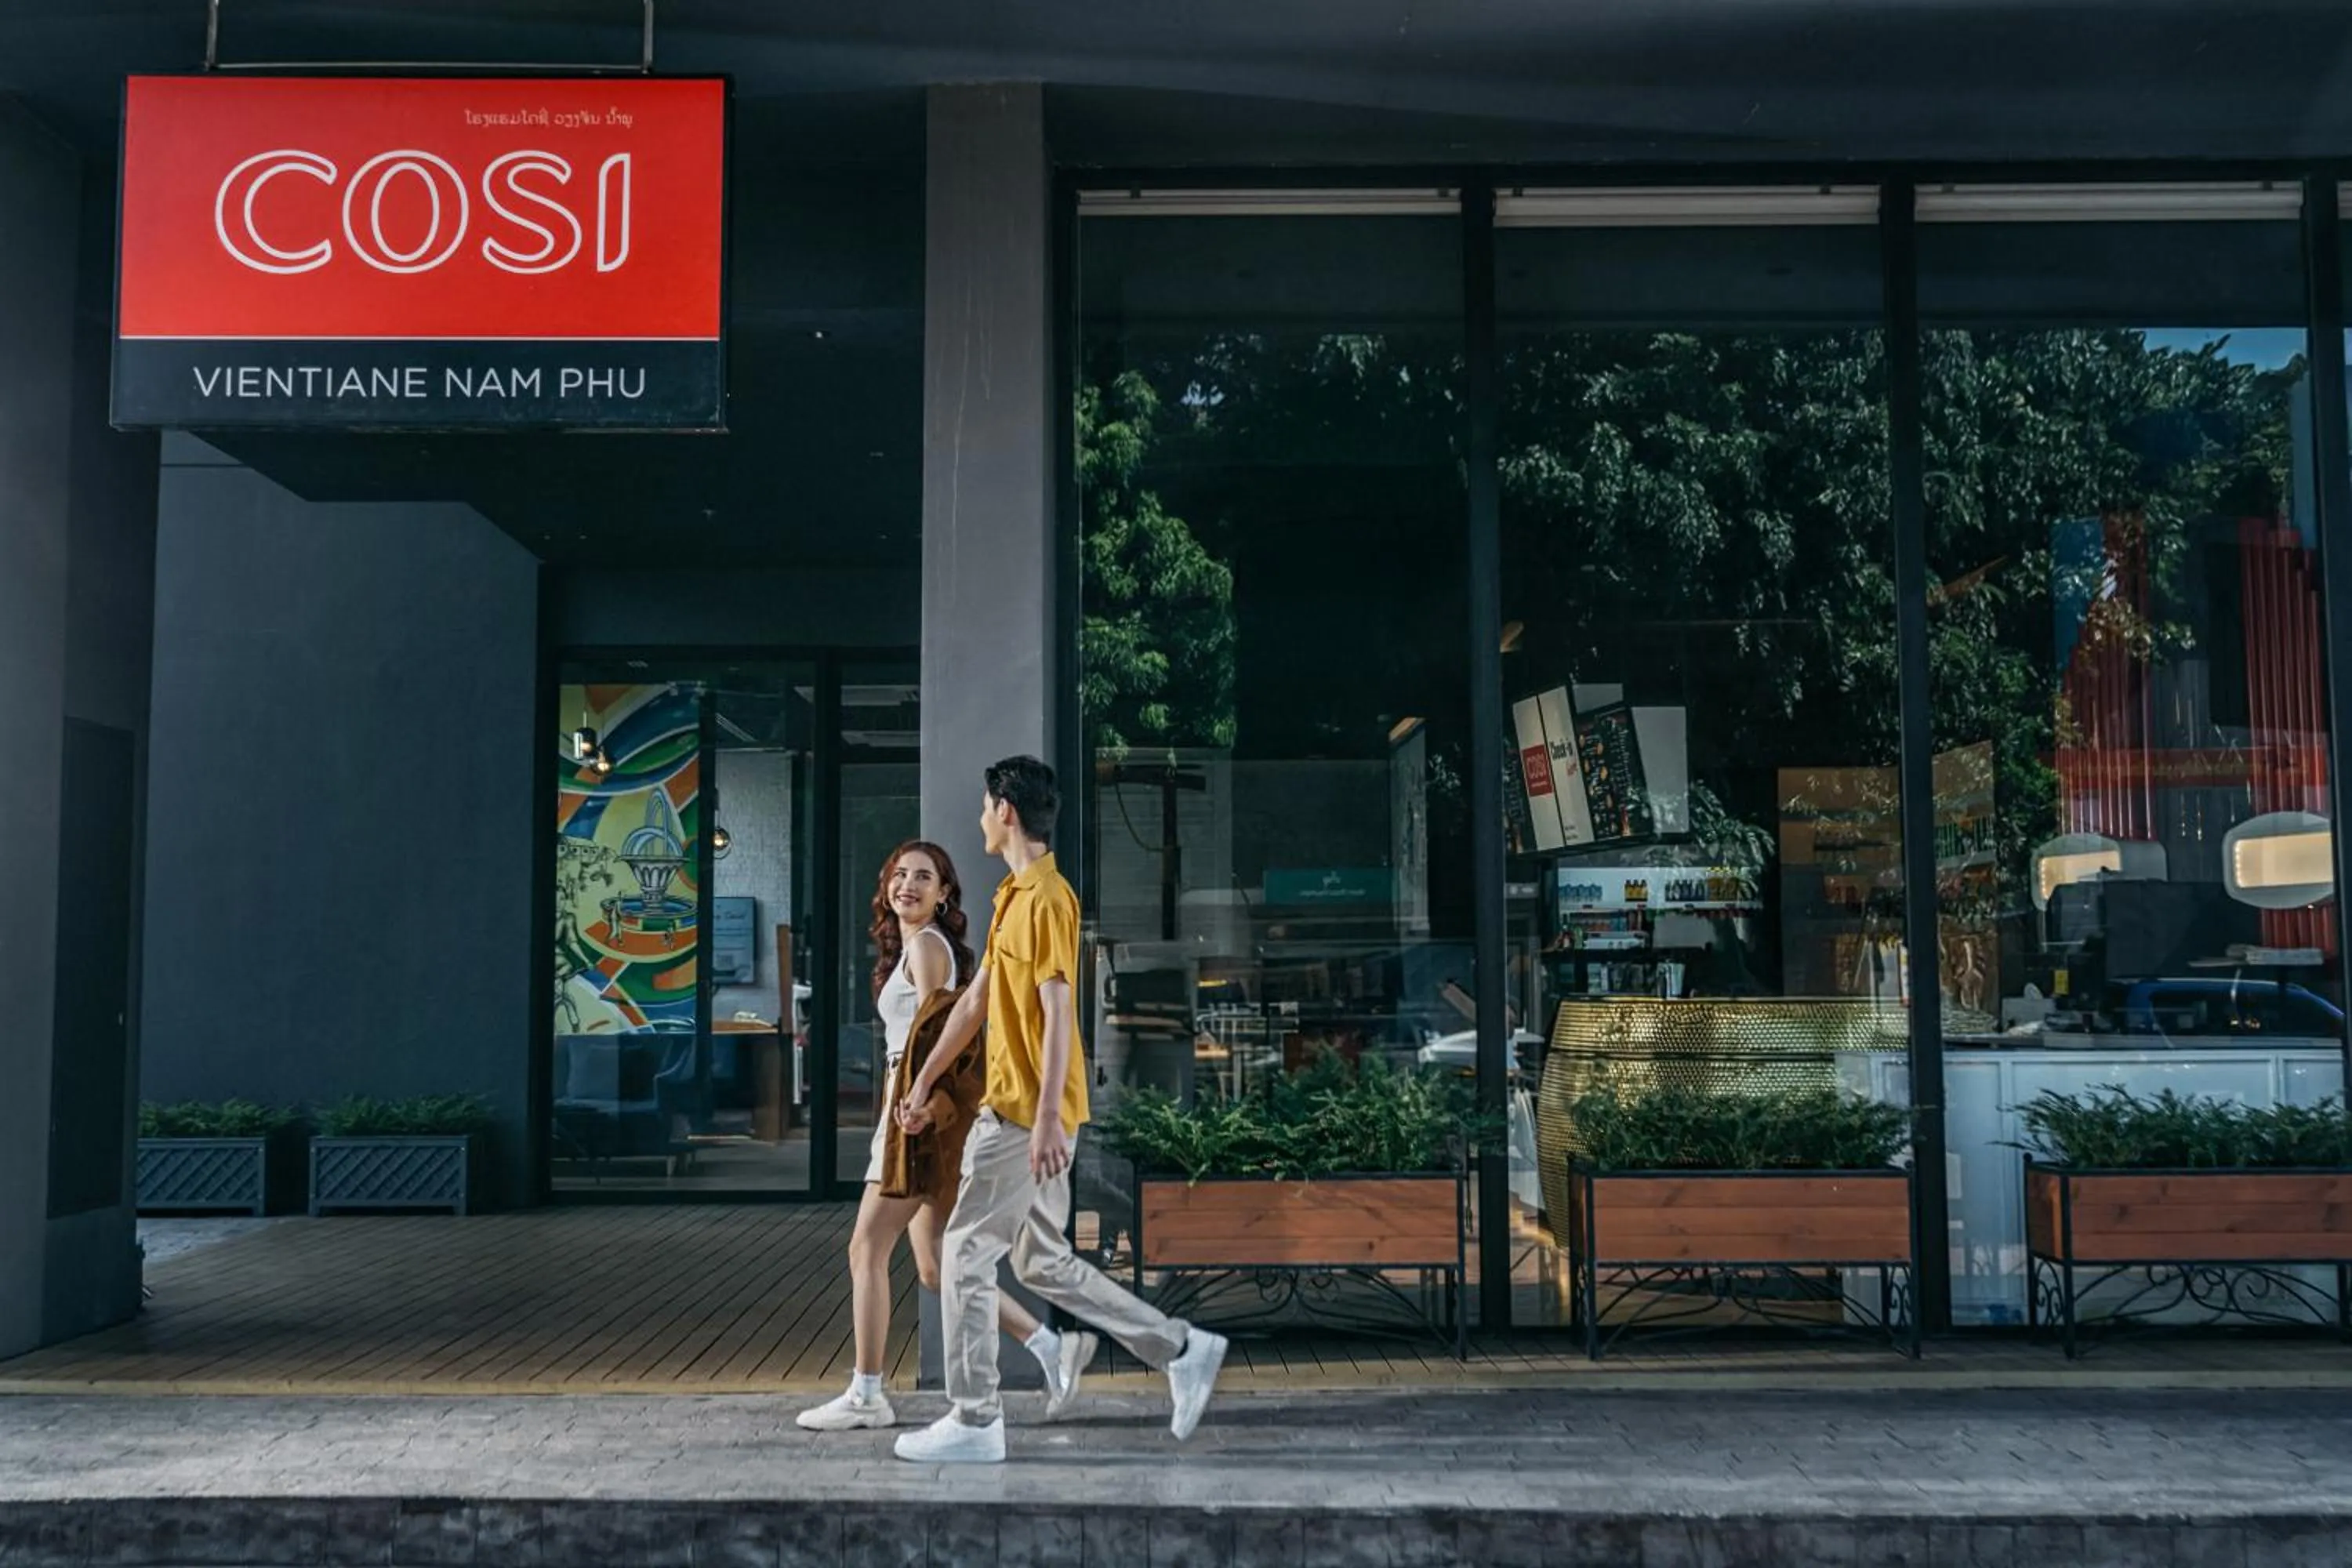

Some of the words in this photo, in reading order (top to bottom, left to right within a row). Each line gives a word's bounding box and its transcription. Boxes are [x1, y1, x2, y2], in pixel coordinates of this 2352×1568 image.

[215, 149, 631, 274] COSI
[193, 366, 427, 398] VIENTIANE
[445, 367, 541, 398] NAM
[559, 367, 647, 398] PHU
